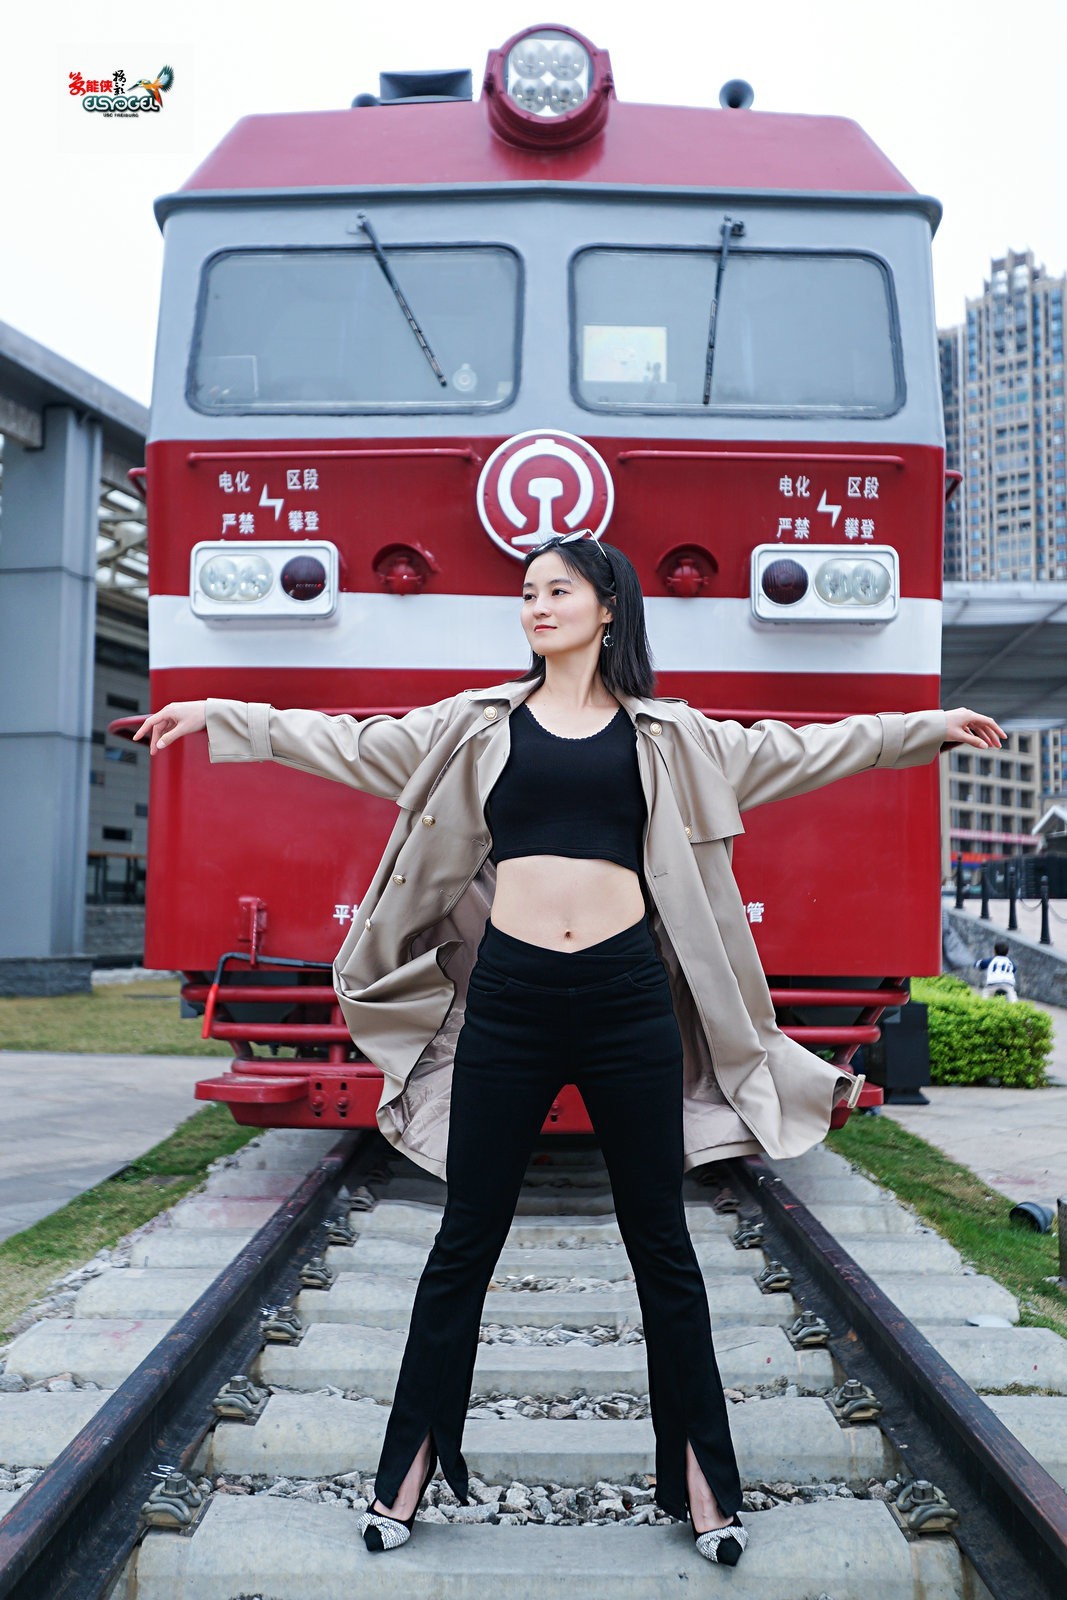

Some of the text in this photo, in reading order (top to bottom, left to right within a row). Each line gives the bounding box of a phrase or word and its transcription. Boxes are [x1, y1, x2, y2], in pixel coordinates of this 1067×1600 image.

[219, 469, 319, 493] 电化 区段
[779, 475, 879, 498] 电化 区段
[222, 510, 319, 534] 严禁 攀登
[776, 517, 875, 540] 严禁 攀登
[743, 902, 765, 923] 管
